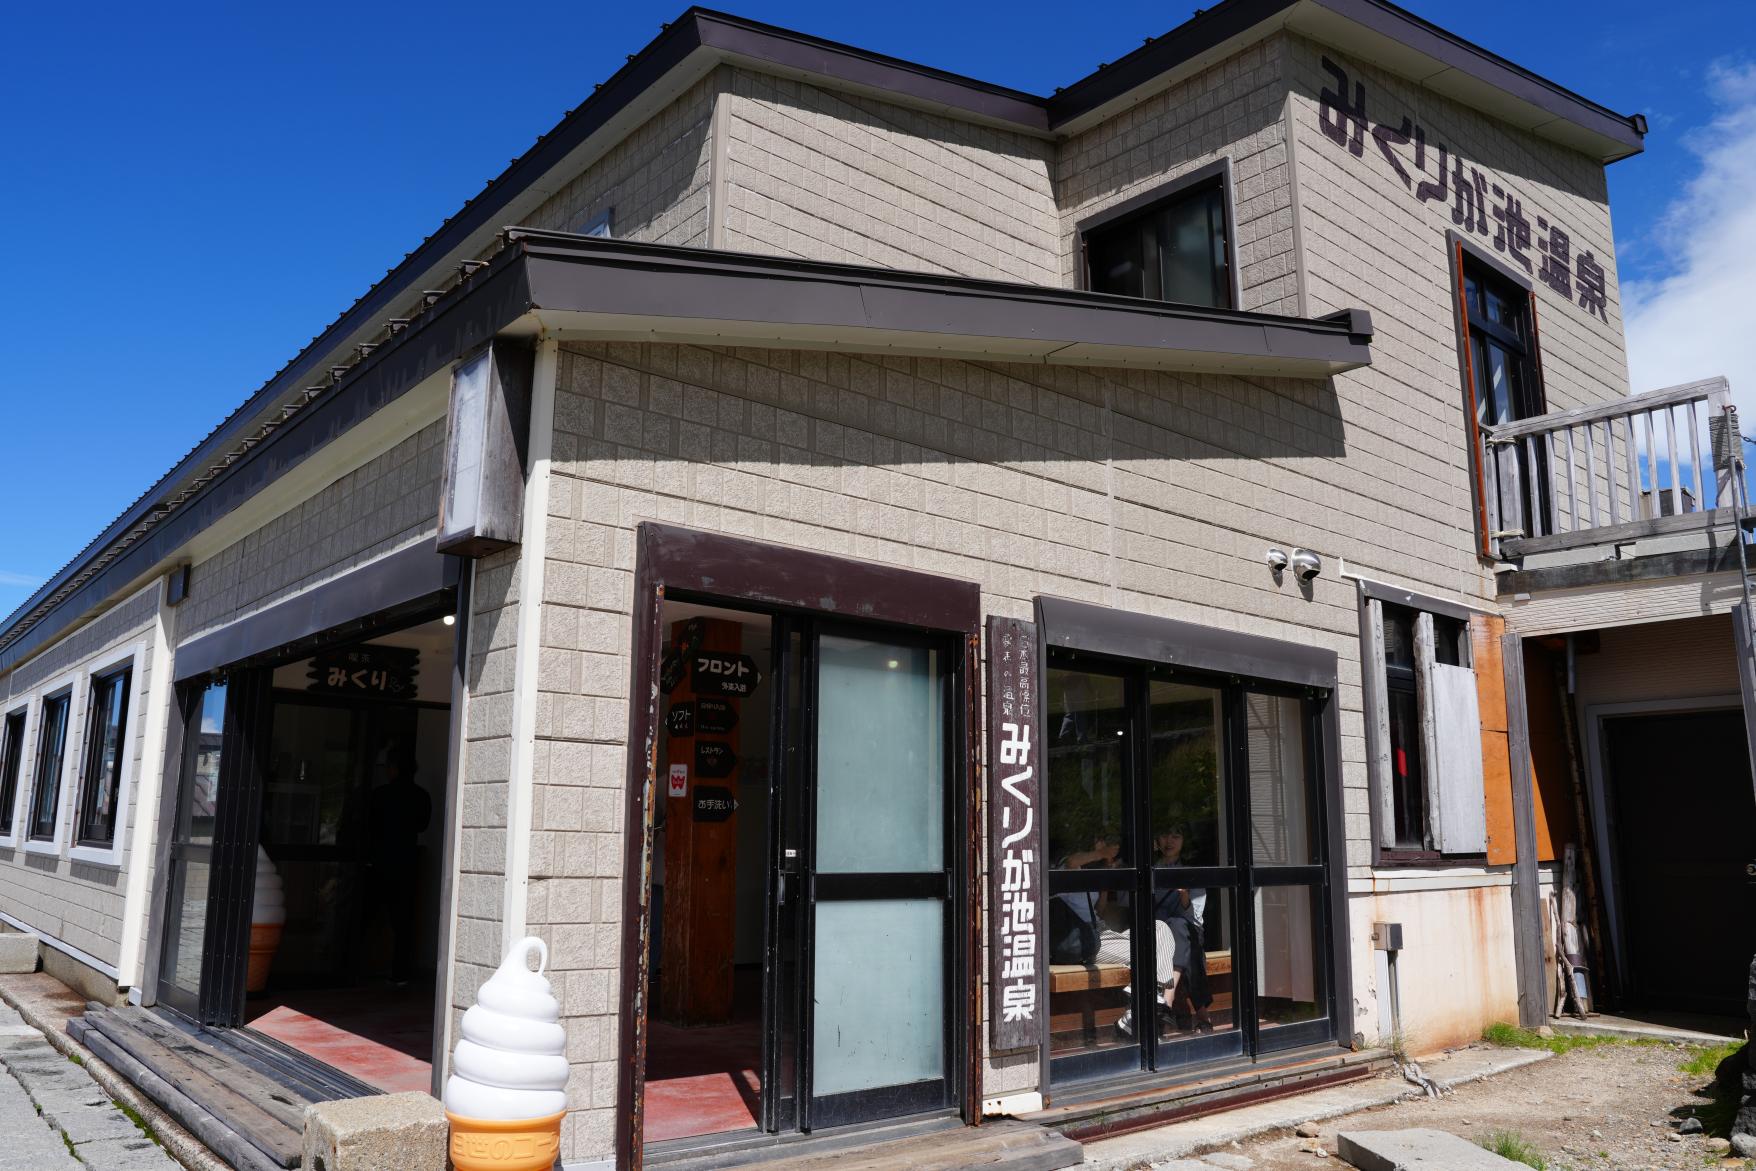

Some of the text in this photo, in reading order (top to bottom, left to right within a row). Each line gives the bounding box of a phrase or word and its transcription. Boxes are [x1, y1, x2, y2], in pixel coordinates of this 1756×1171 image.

[1319, 55, 1609, 324] みくりが池温泉
[327, 667, 387, 690] みくり
[697, 658, 750, 678] フロント
[672, 708, 692, 721] ソフト
[1000, 722, 1036, 1022] みくりが池温泉
